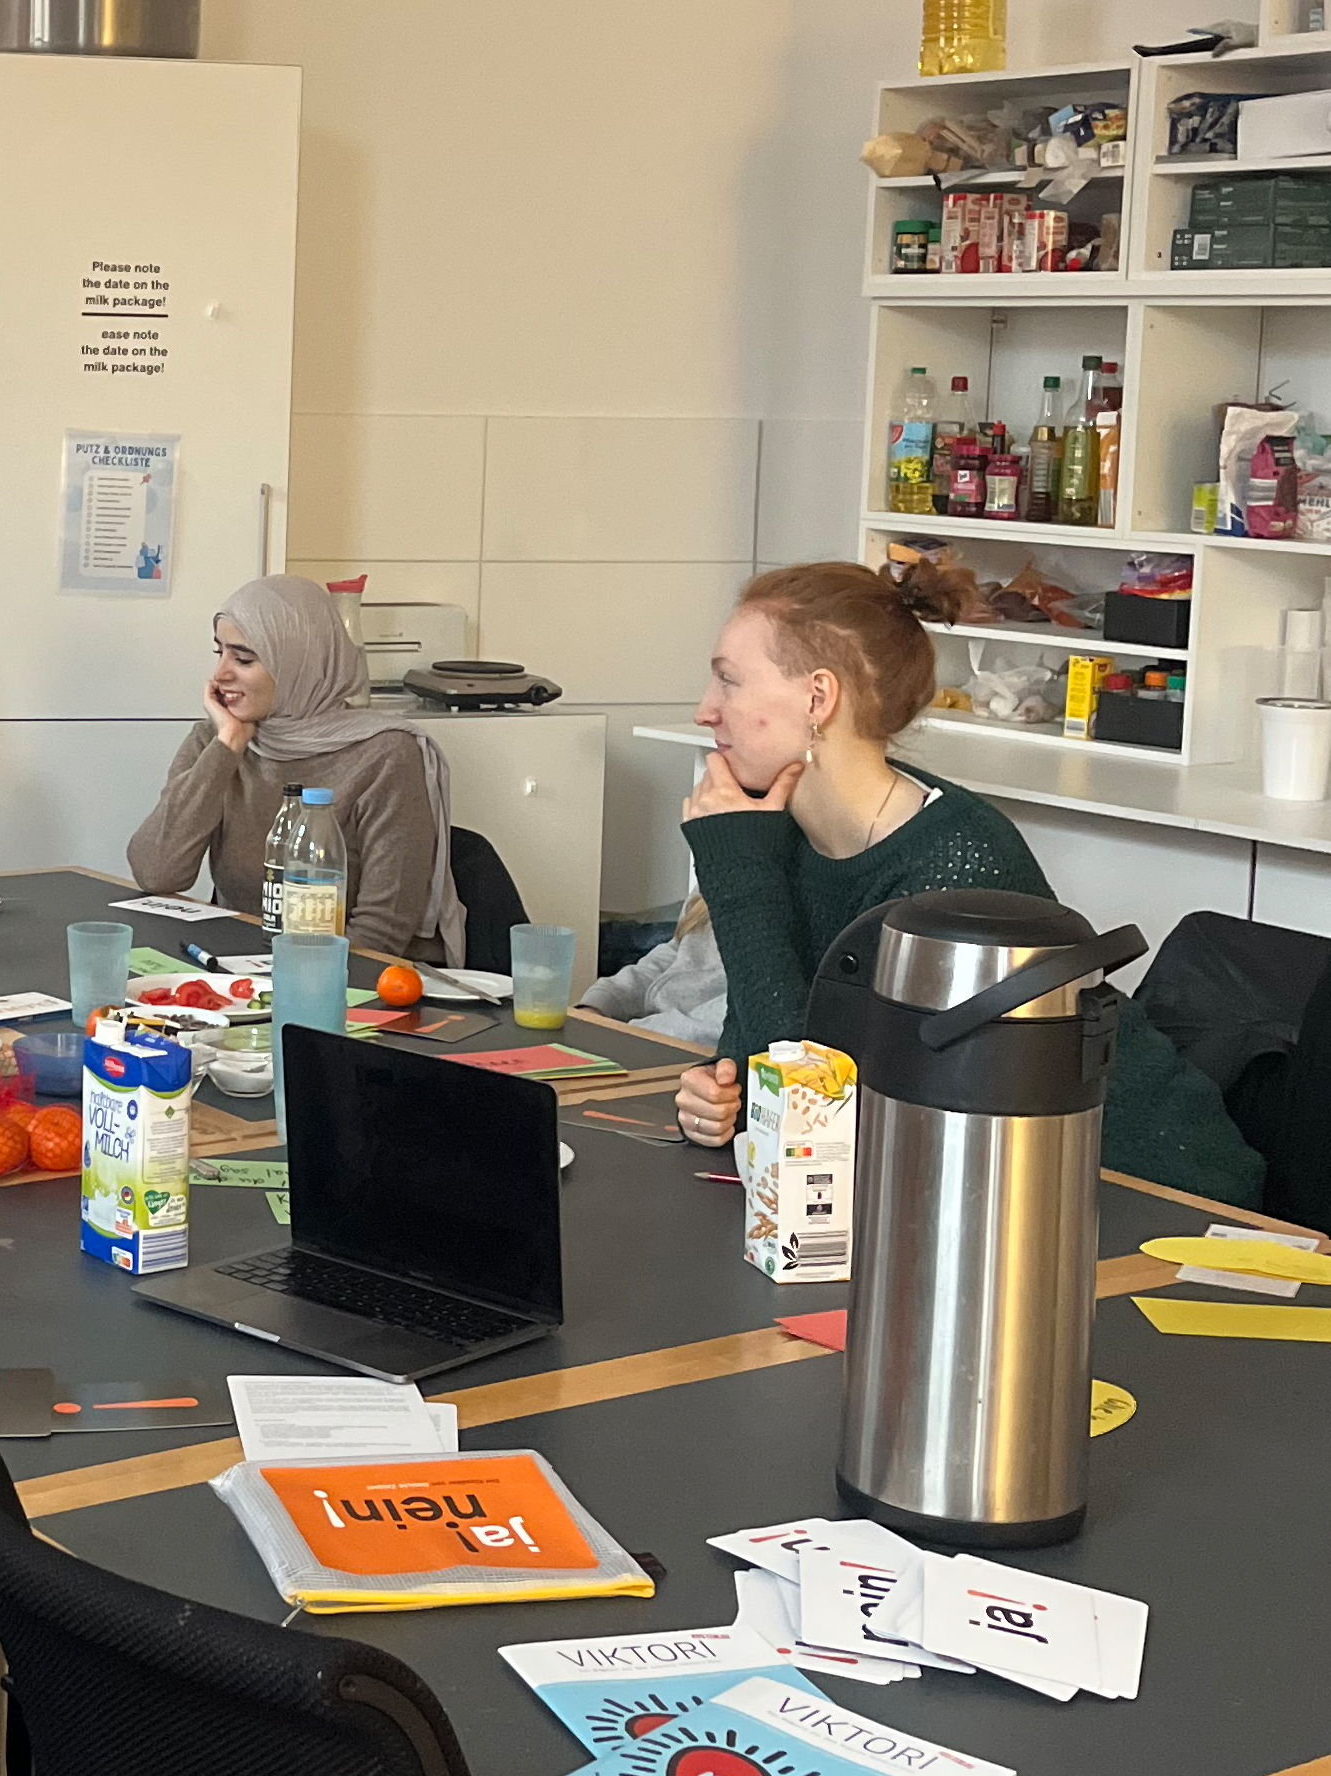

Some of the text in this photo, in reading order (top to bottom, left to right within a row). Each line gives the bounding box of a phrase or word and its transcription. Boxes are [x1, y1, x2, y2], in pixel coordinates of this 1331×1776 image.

[92, 261, 161, 274] Please note
[82, 278, 170, 291] the date on the
[85, 295, 167, 309] milk package!
[133, 330, 159, 340] note
[81, 345, 169, 357] the date on the
[83, 362, 165, 375] milk package!
[76, 443, 167, 457] PUTZ & ORDNUNGS
[91, 456, 151, 468] CHECKLISTE
[89, 1103, 121, 1135] VOLL-
[94, 1130, 130, 1164] MILCH
[313, 1489, 487, 1530] nein!
[445, 1516, 541, 1553] ja!
[967, 1589, 1049, 1645] ja!
[556, 1640, 718, 1668] VIKTORI
[779, 1697, 939, 1770] VIKTORI
